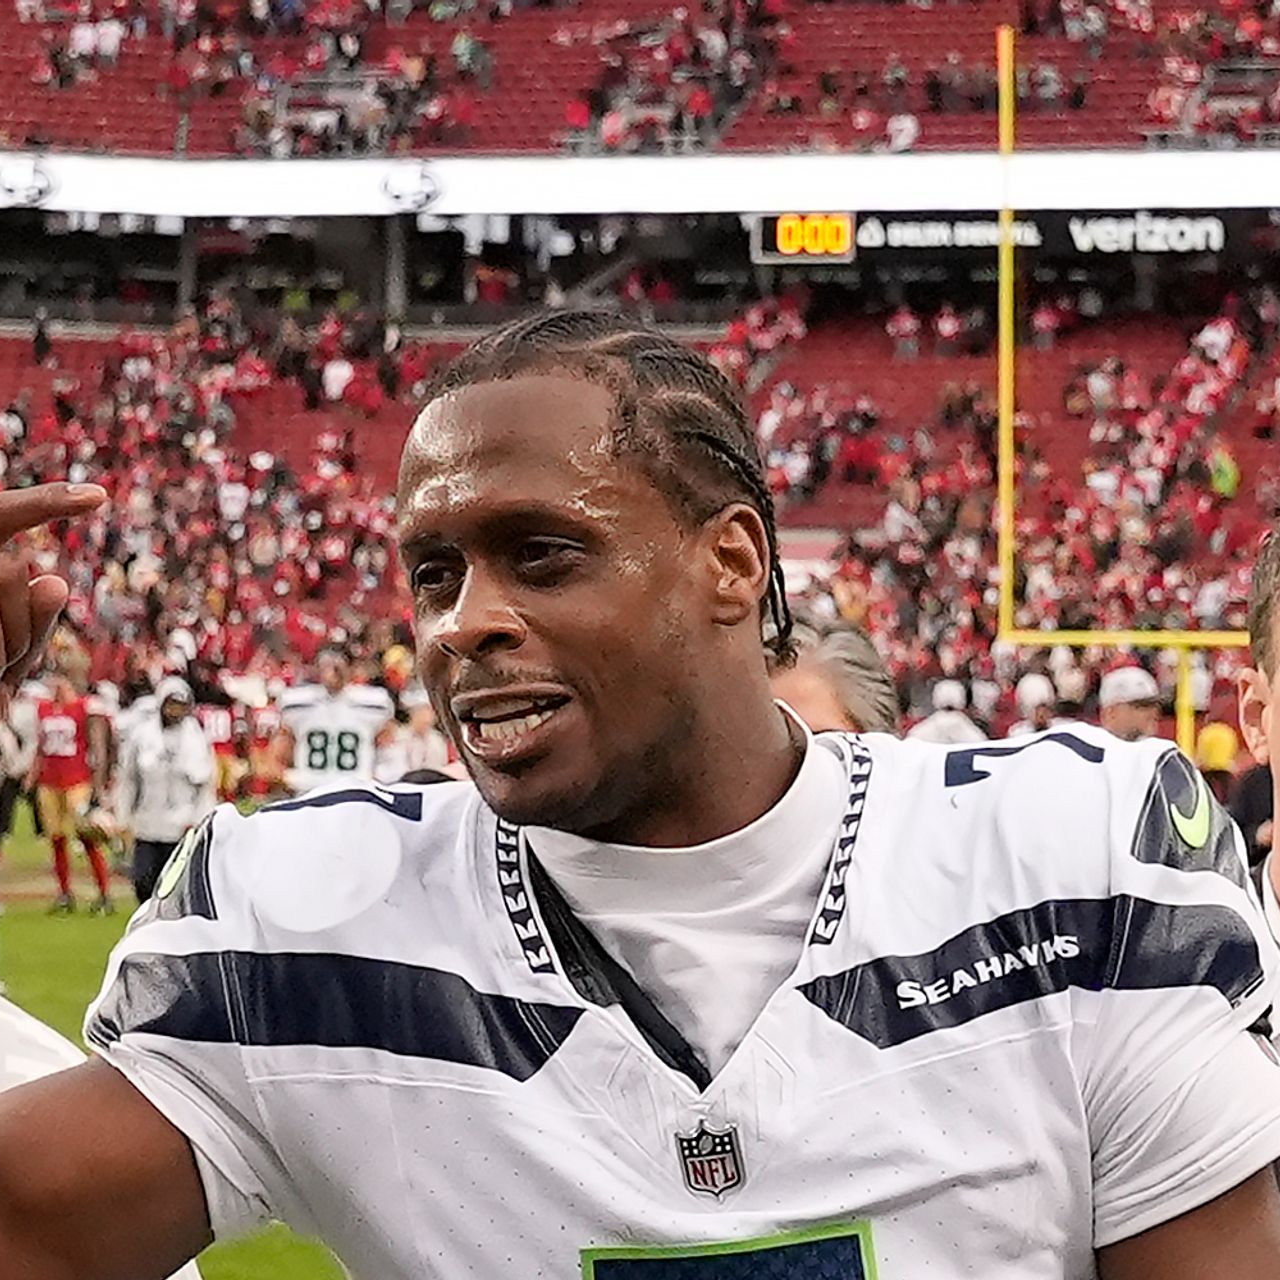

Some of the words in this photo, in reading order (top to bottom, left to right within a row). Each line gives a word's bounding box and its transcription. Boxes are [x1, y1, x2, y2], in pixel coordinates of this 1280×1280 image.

[1069, 211, 1224, 252] verizon
[307, 730, 360, 771] 88
[896, 934, 1081, 1010] SEAHAWKS
[689, 1156, 736, 1189] NFL
